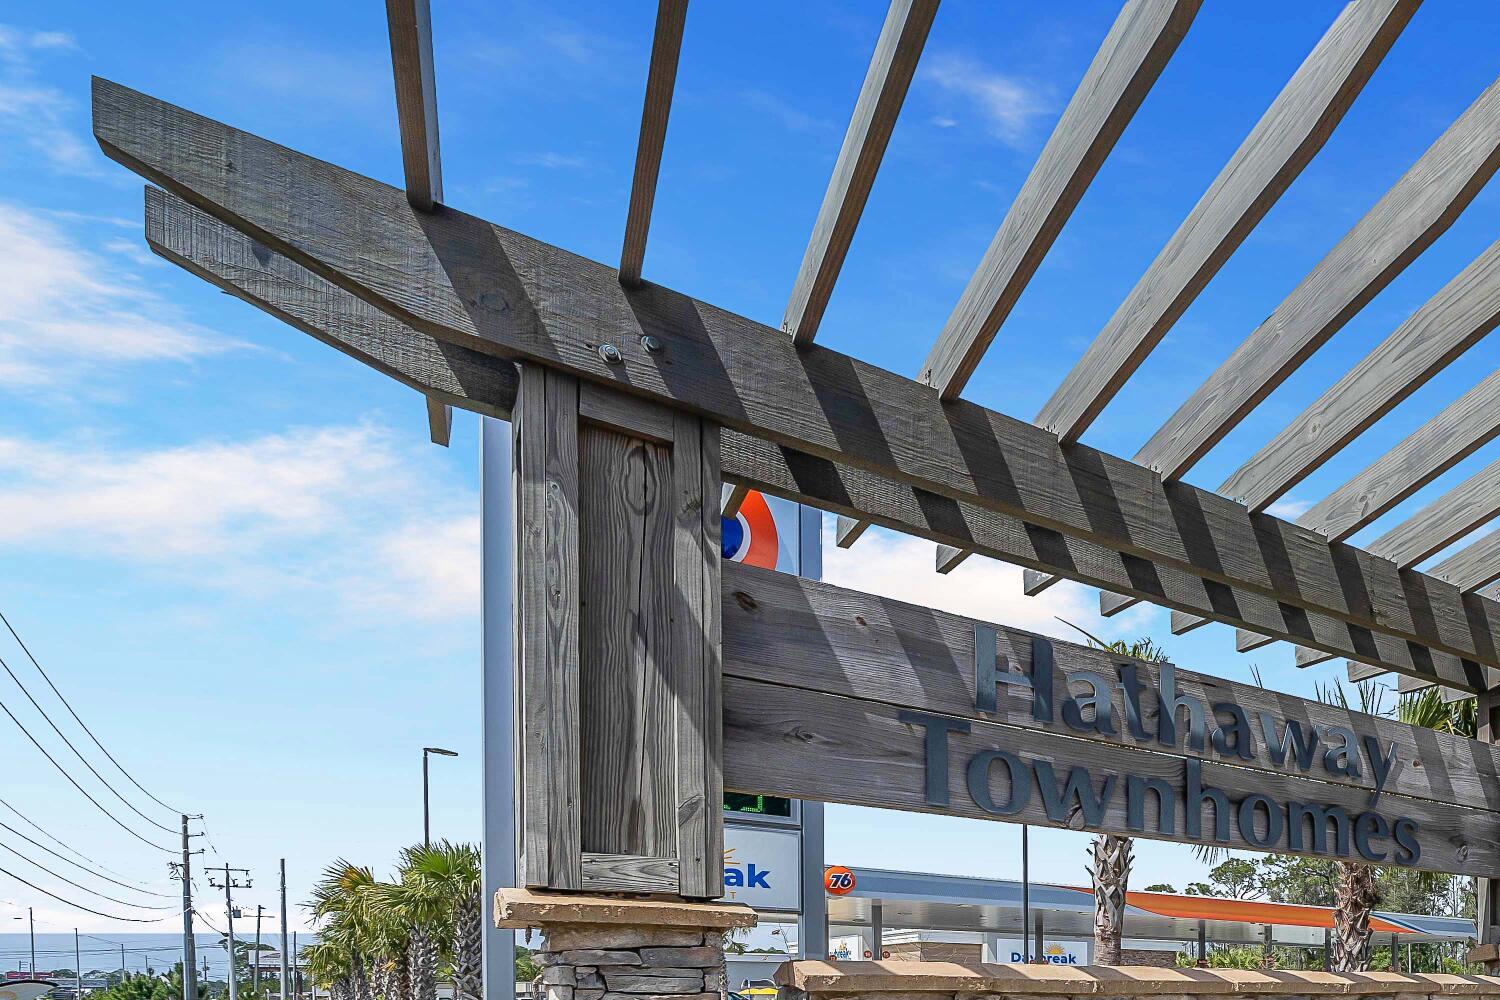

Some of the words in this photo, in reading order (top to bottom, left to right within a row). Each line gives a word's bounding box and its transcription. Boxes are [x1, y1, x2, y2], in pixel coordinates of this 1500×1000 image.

[899, 710, 1422, 867] Townhomes
[974, 623, 1399, 808] Hathaway
[829, 873, 852, 889] 76
